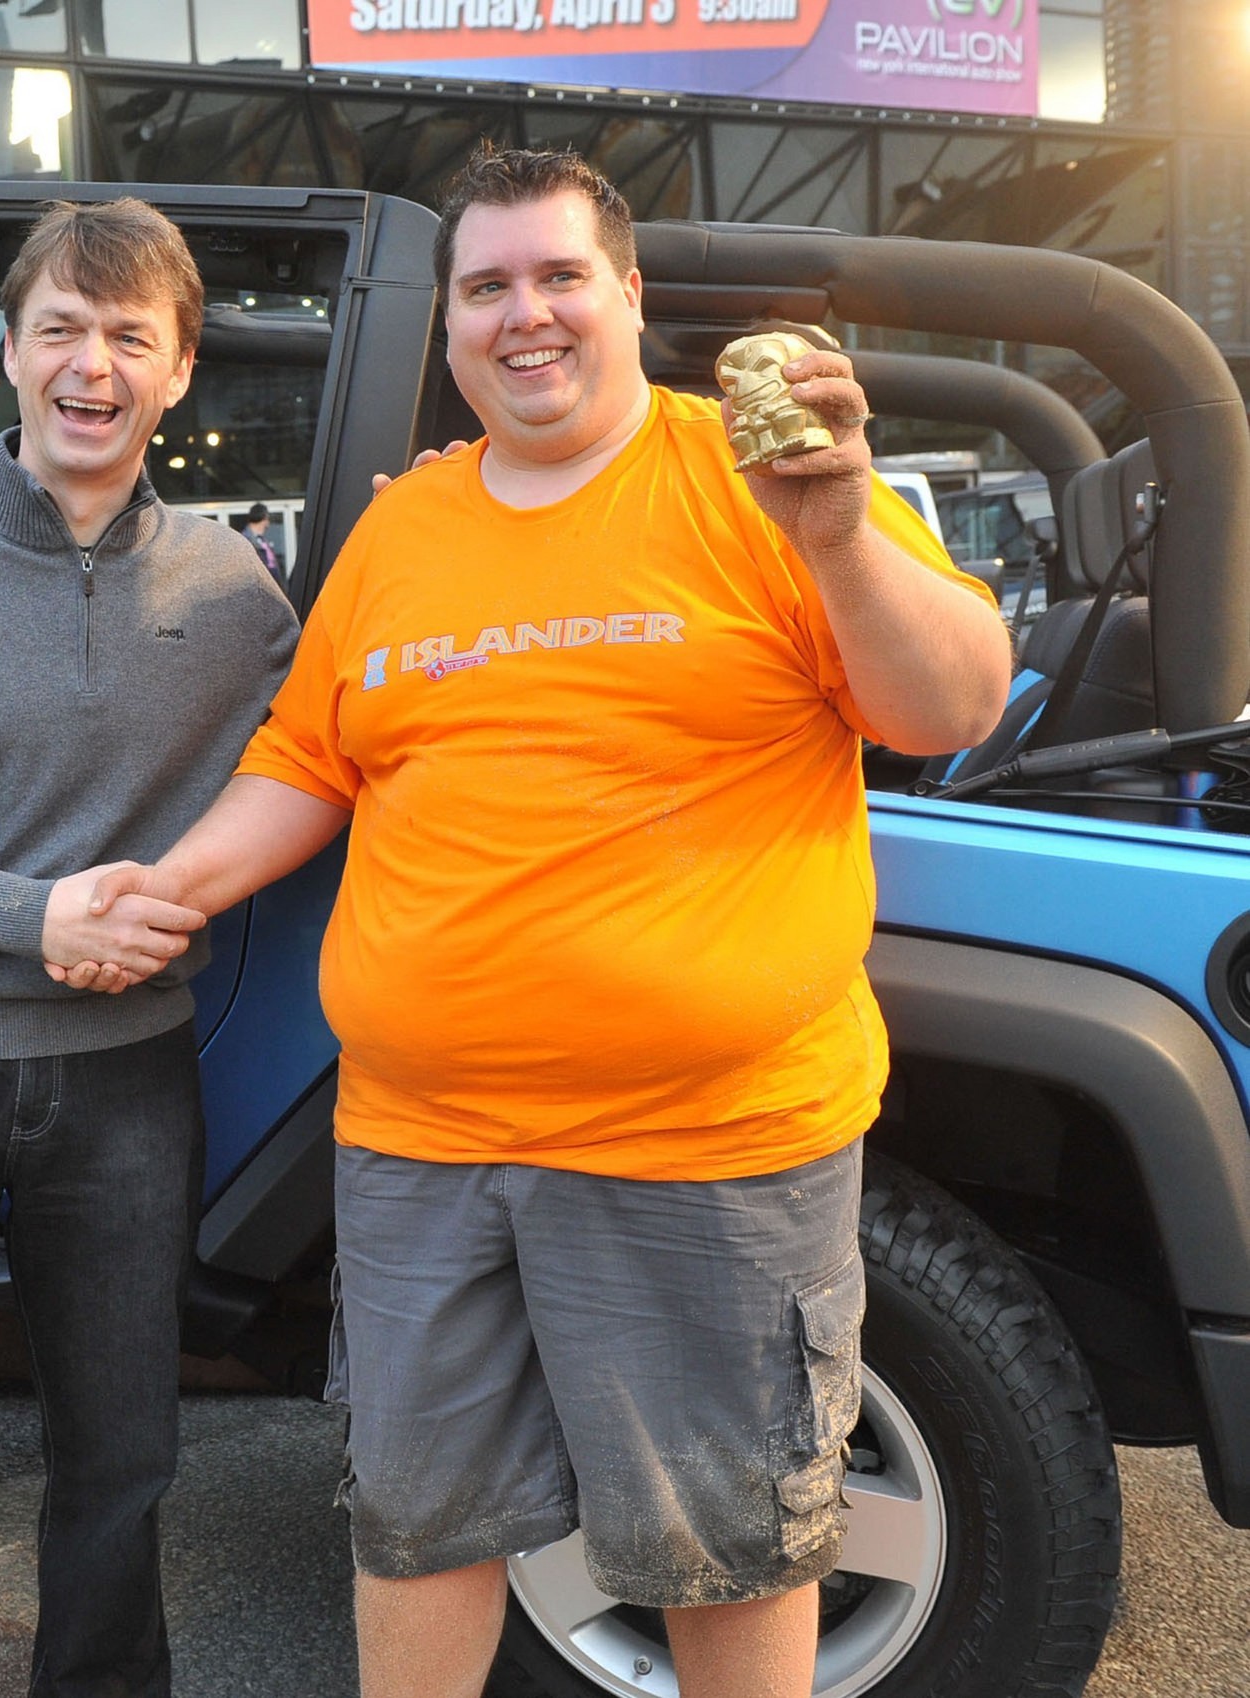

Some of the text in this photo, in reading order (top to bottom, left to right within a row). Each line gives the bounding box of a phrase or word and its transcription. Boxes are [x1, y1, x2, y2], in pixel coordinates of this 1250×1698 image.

[350, 0, 543, 31] Saturday,
[551, 0, 643, 28] April
[855, 21, 1023, 64] PAVILION
[400, 612, 686, 673] ISLANDER
